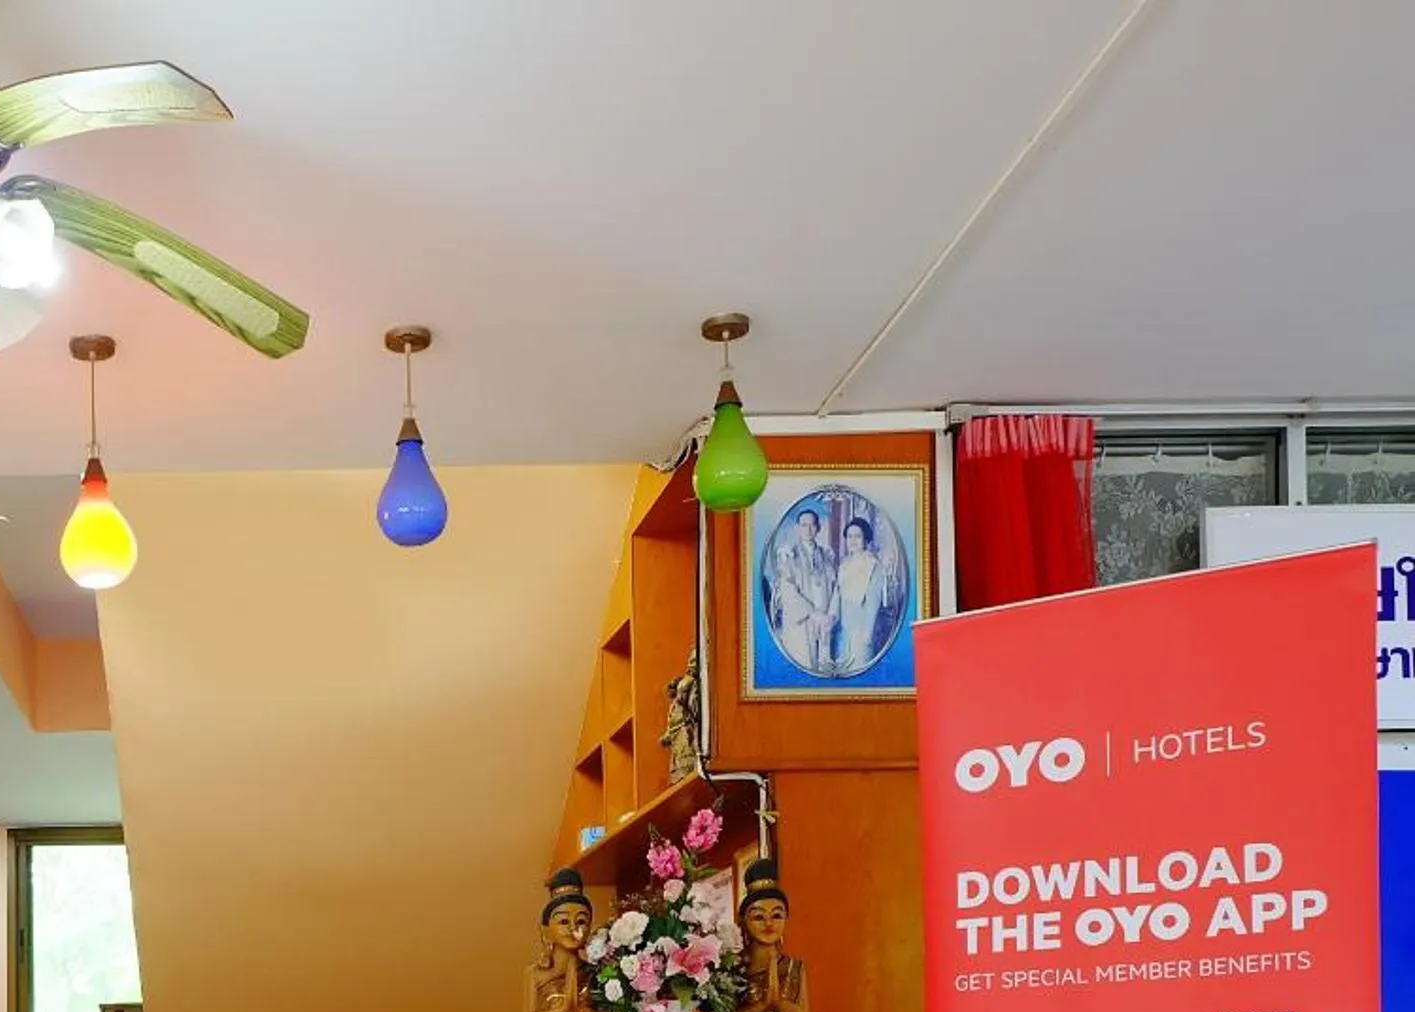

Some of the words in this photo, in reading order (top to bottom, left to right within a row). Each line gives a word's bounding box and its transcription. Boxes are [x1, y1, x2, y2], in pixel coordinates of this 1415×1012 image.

[954, 737, 1085, 793] OYO
[1133, 721, 1267, 763] HOTELS
[957, 842, 1283, 910] DOWNLOAD
[955, 911, 1061, 956] THE
[1074, 902, 1191, 946] OYO
[1206, 889, 1329, 938] APP
[954, 972, 995, 993] GET
[1001, 965, 1088, 989] SPECIAL
[1095, 959, 1192, 984] MEMBER
[1199, 951, 1312, 978] BENEFITS
